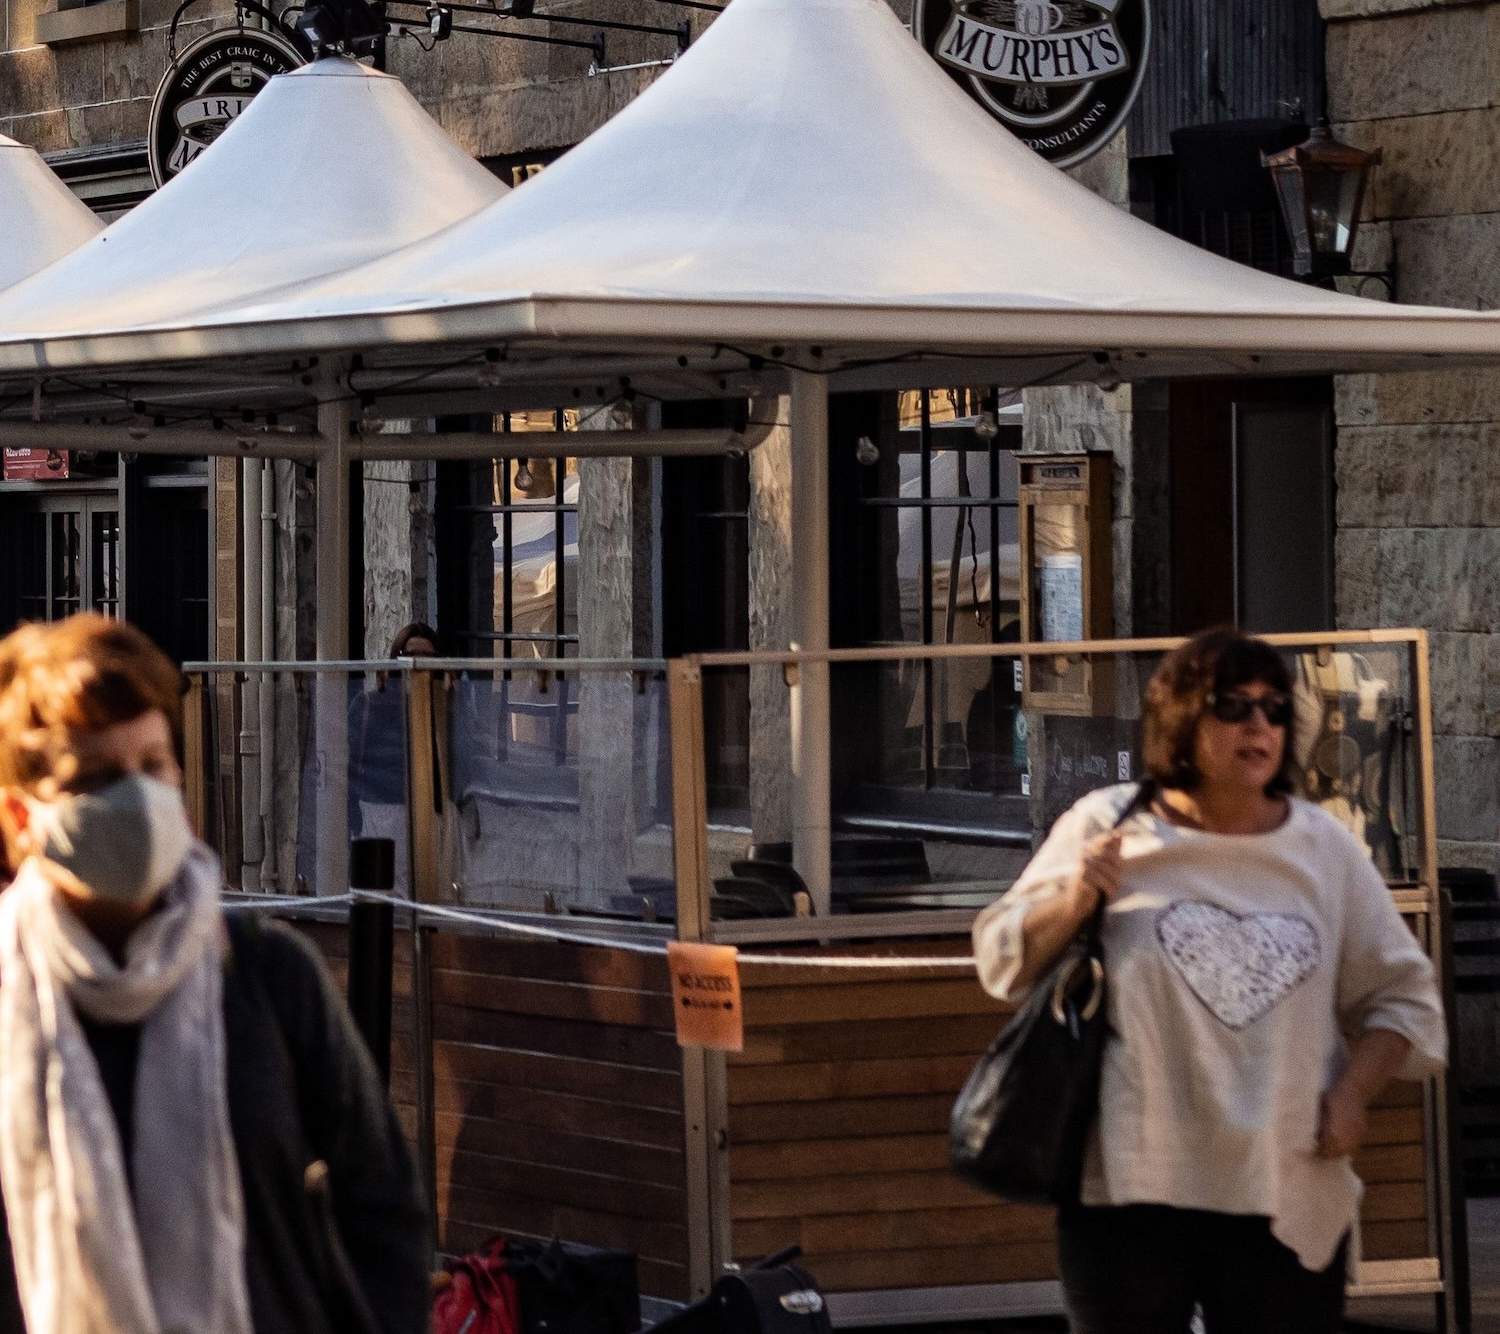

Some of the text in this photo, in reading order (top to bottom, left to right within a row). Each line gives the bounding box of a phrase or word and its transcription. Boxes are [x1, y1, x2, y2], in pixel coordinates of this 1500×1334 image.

[181, 47, 276, 90] THE BEST CRAIC IN
